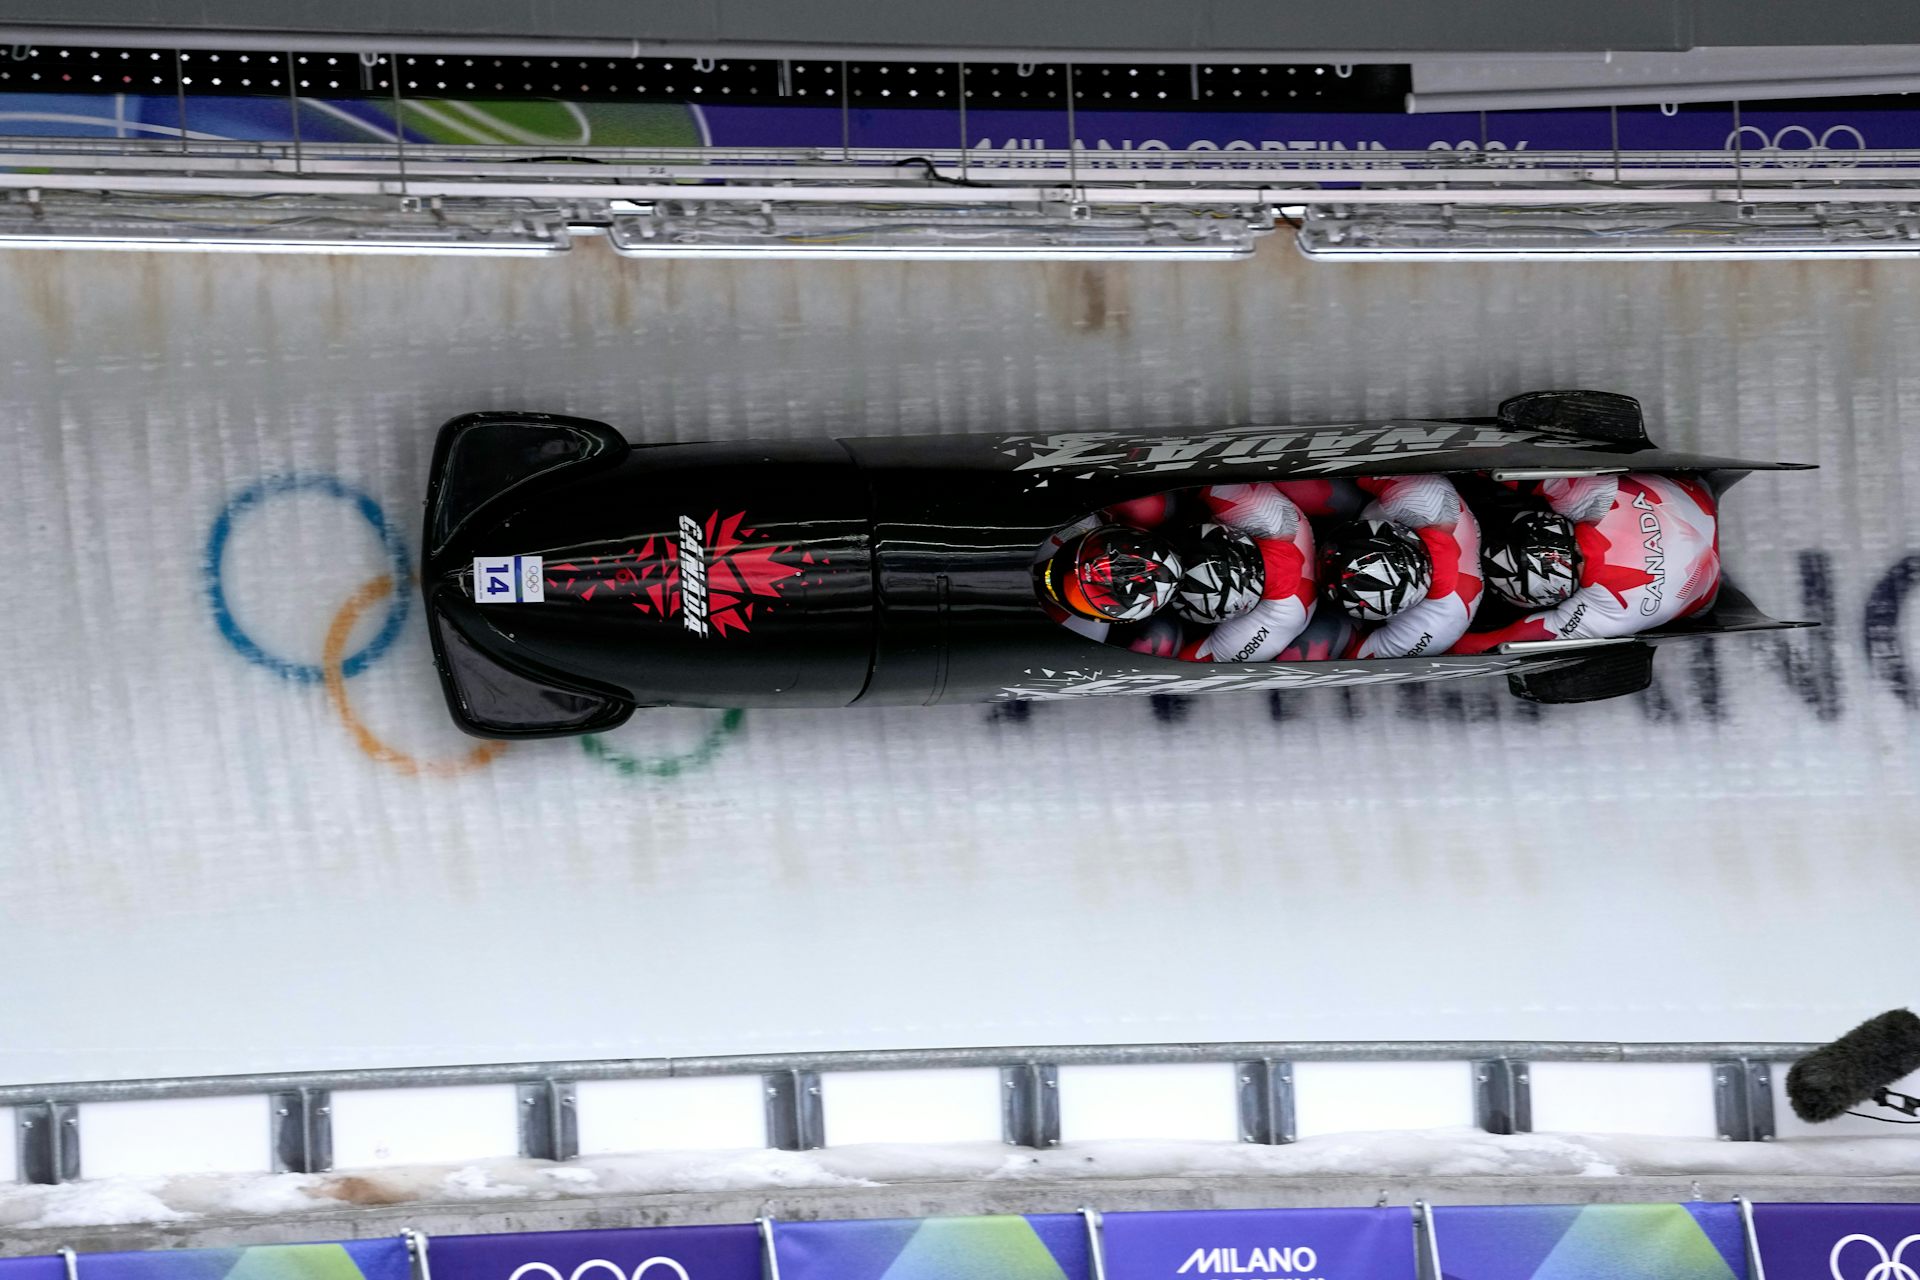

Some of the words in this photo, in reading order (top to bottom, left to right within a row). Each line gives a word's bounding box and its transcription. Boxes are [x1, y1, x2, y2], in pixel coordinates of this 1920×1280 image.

[1632, 491, 1667, 617] CANADA
[486, 564, 510, 595] 14
[678, 514, 709, 638] CANADA
[1560, 602, 1588, 637] KARBON
[1403, 631, 1433, 658] KARB
[1176, 1246, 1318, 1274] MILANO
